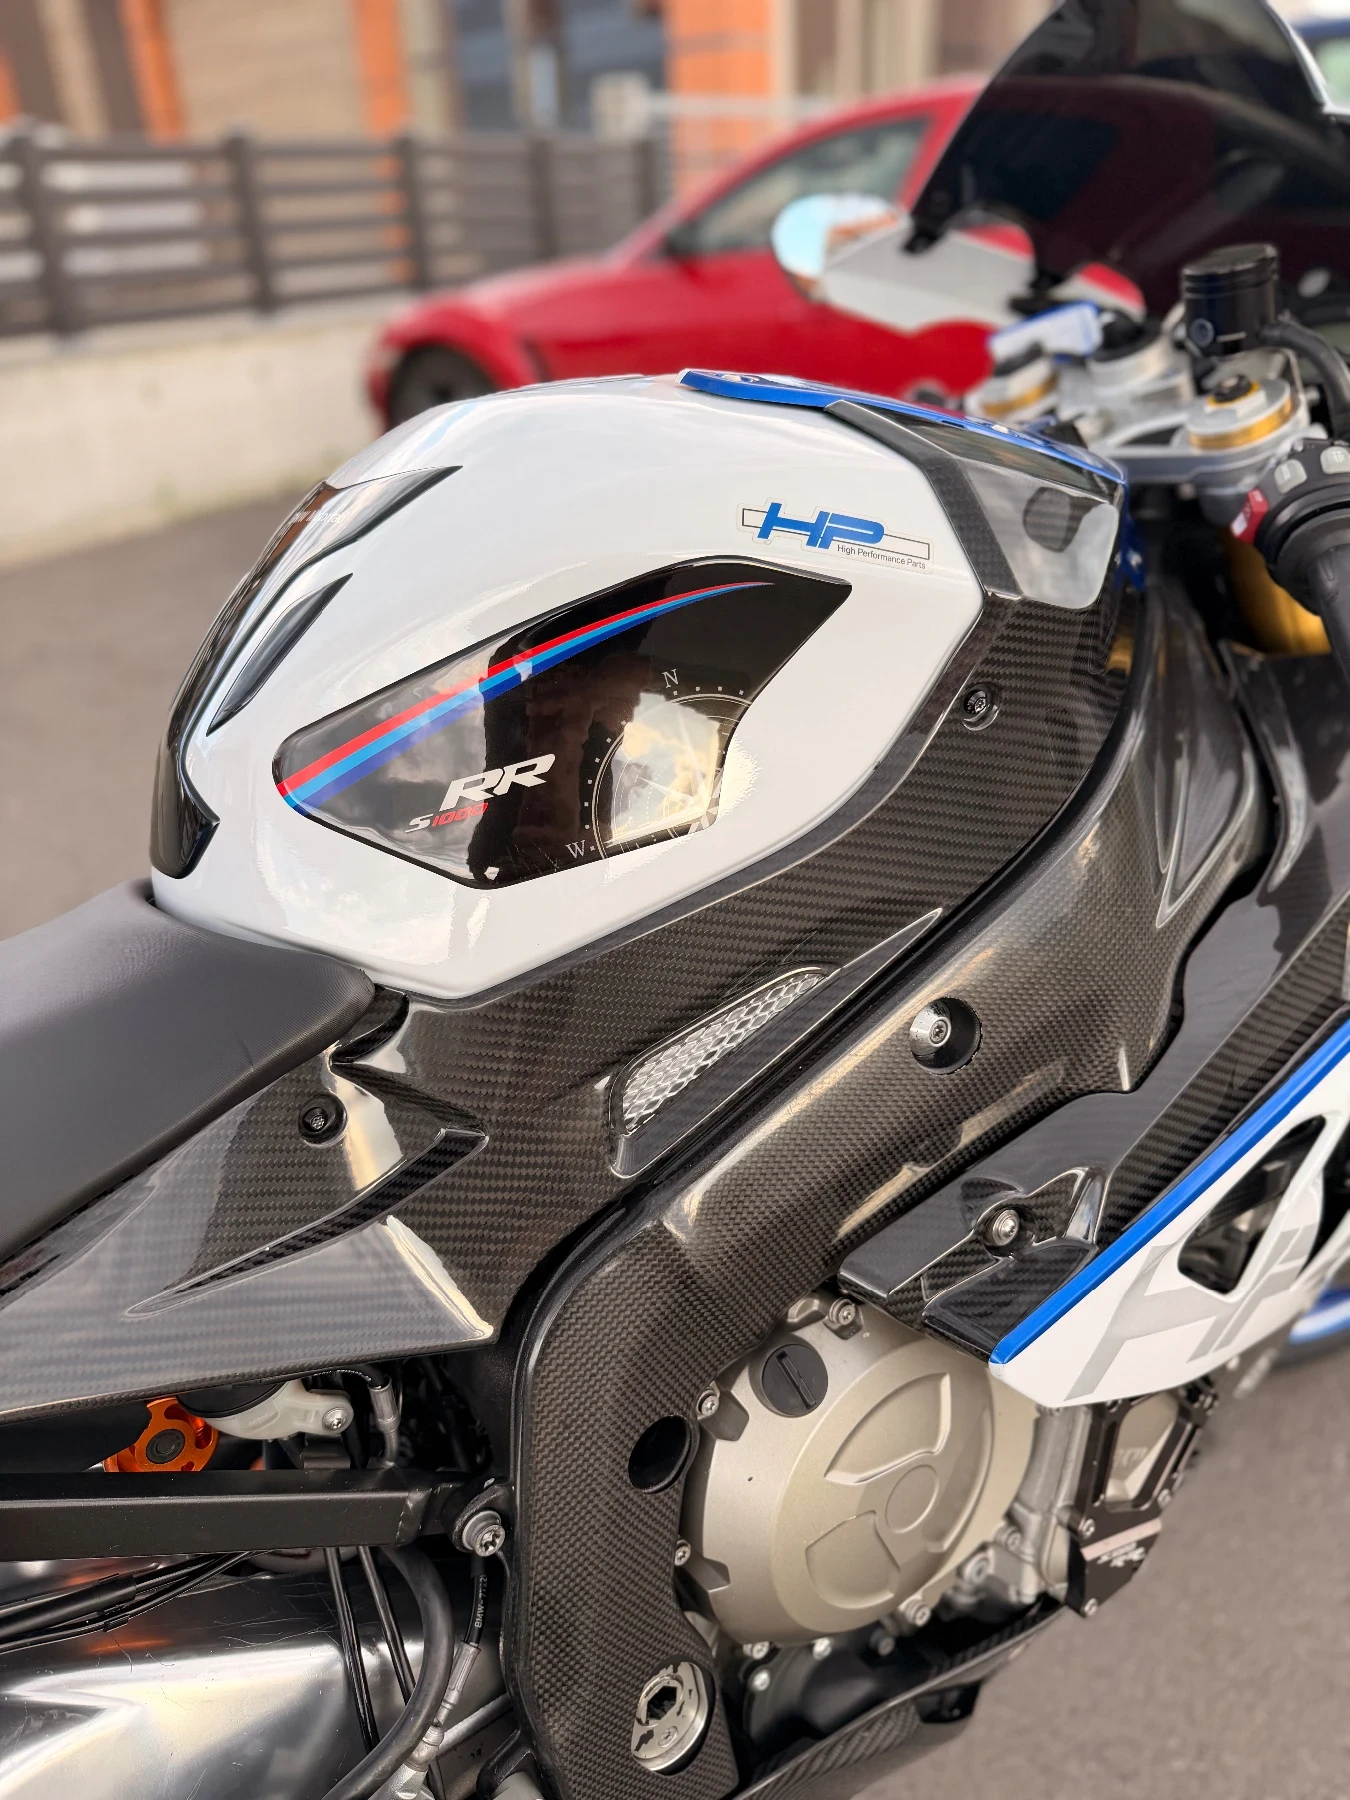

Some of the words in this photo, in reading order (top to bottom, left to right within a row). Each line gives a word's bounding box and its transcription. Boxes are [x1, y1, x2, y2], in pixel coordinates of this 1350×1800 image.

[757, 502, 885, 549] HP
[837, 544, 856, 556] High
[857, 547, 906, 565] Performance
[906, 557, 927, 570] Parts
[661, 668, 679, 689] N
[439, 753, 556, 812] RR
[404, 802, 489, 833] S1000
[565, 839, 586, 860] W
